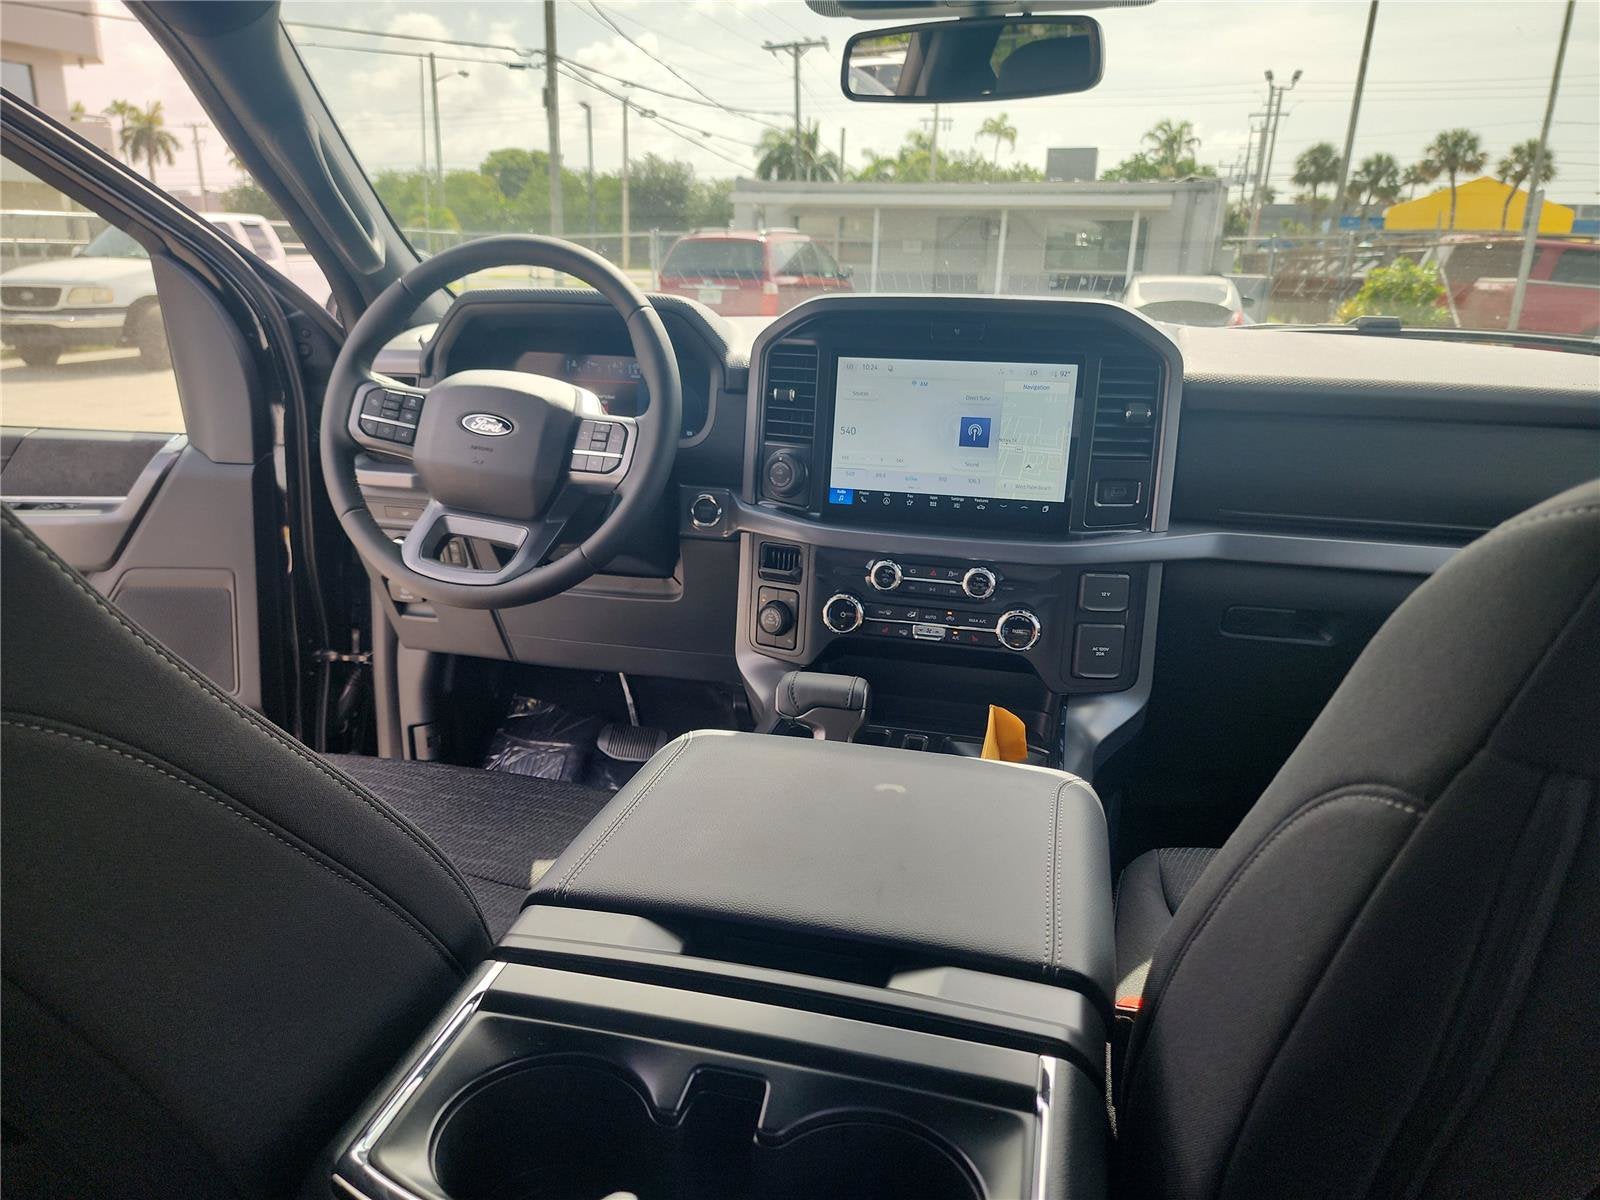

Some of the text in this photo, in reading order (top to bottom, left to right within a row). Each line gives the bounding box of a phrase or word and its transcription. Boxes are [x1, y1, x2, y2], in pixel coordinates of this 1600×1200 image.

[1022, 383, 1050, 391] Navigation
[471, 416, 503, 433] Ford
[840, 426, 857, 435] 540
